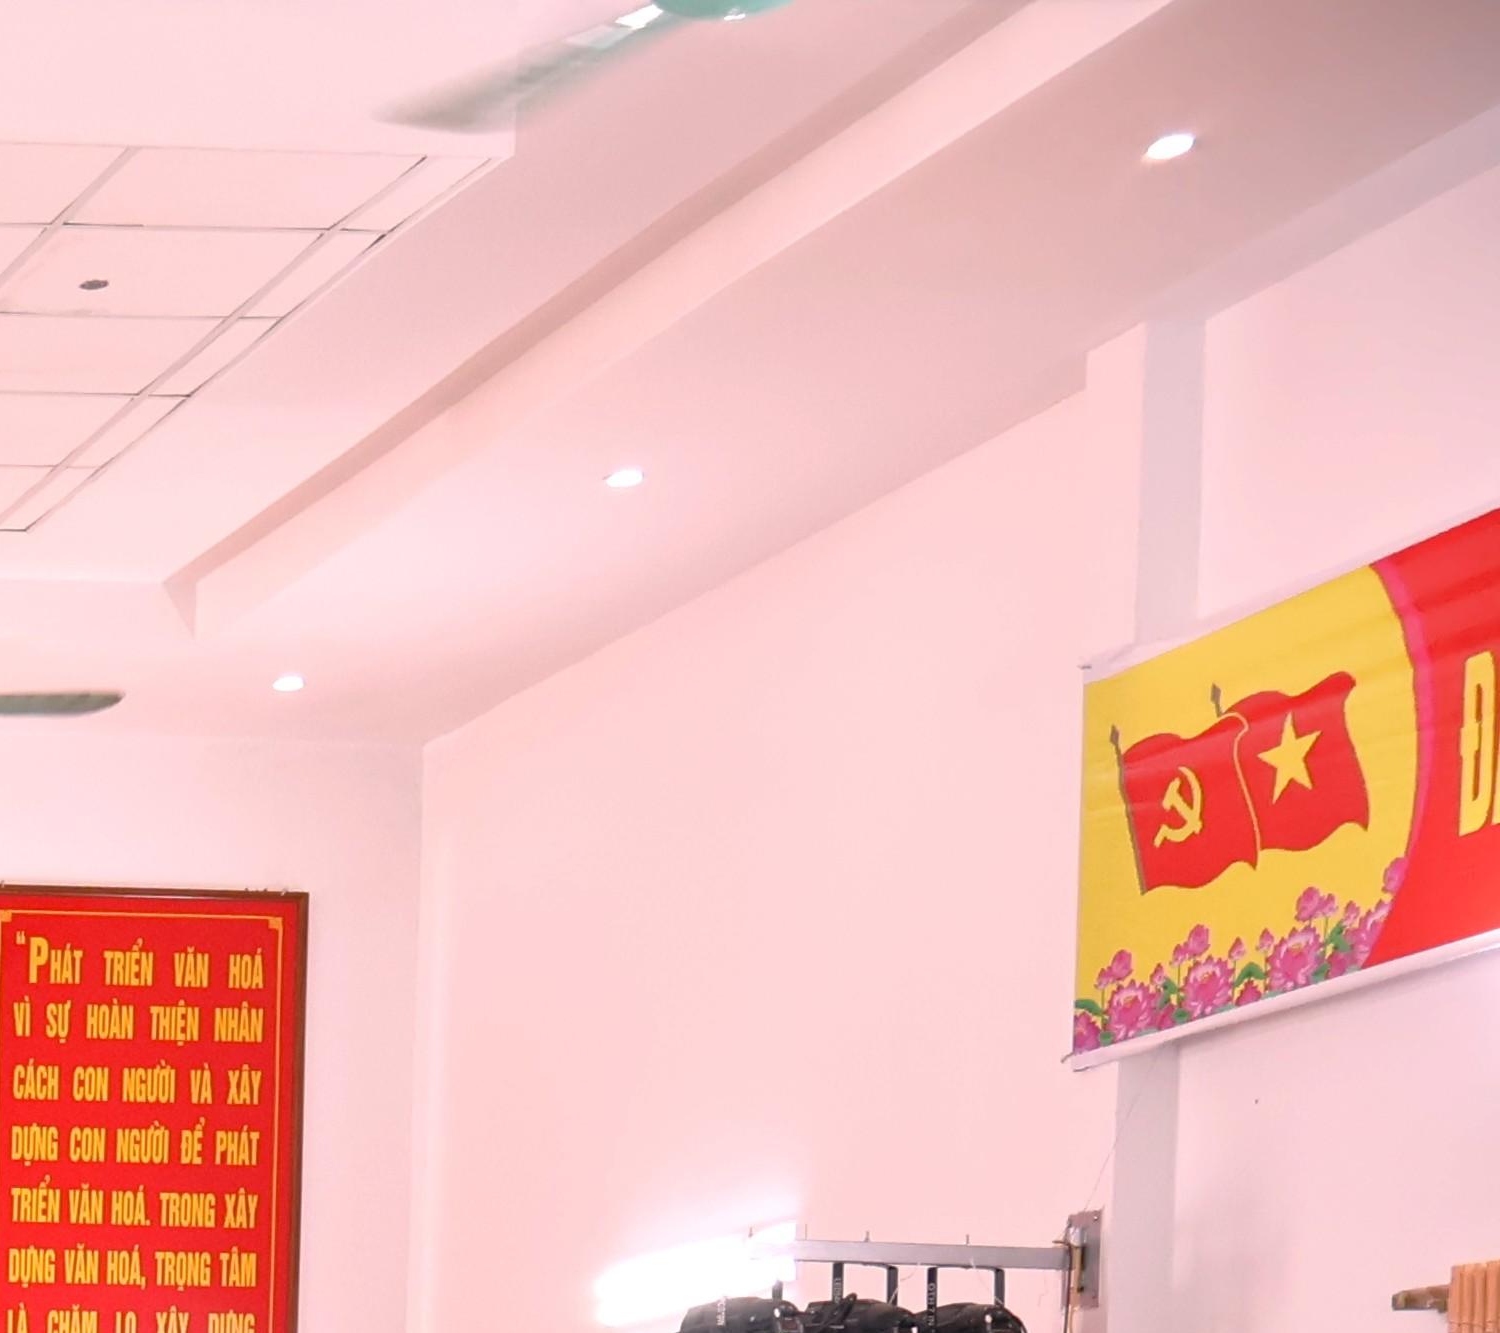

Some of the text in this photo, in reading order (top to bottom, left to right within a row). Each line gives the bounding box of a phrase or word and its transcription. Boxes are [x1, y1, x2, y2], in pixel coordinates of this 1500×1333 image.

[104, 939, 153, 986] TRIỂN
[175, 947, 208, 987] VĂN
[229, 948, 263, 989] HOÁ
[14, 996, 263, 1046] VÌ SỰ HOÀN THIỆN NHÂN
[13, 1059, 261, 1104] CÁCH CON NGƯỜI VÀ XÂY
